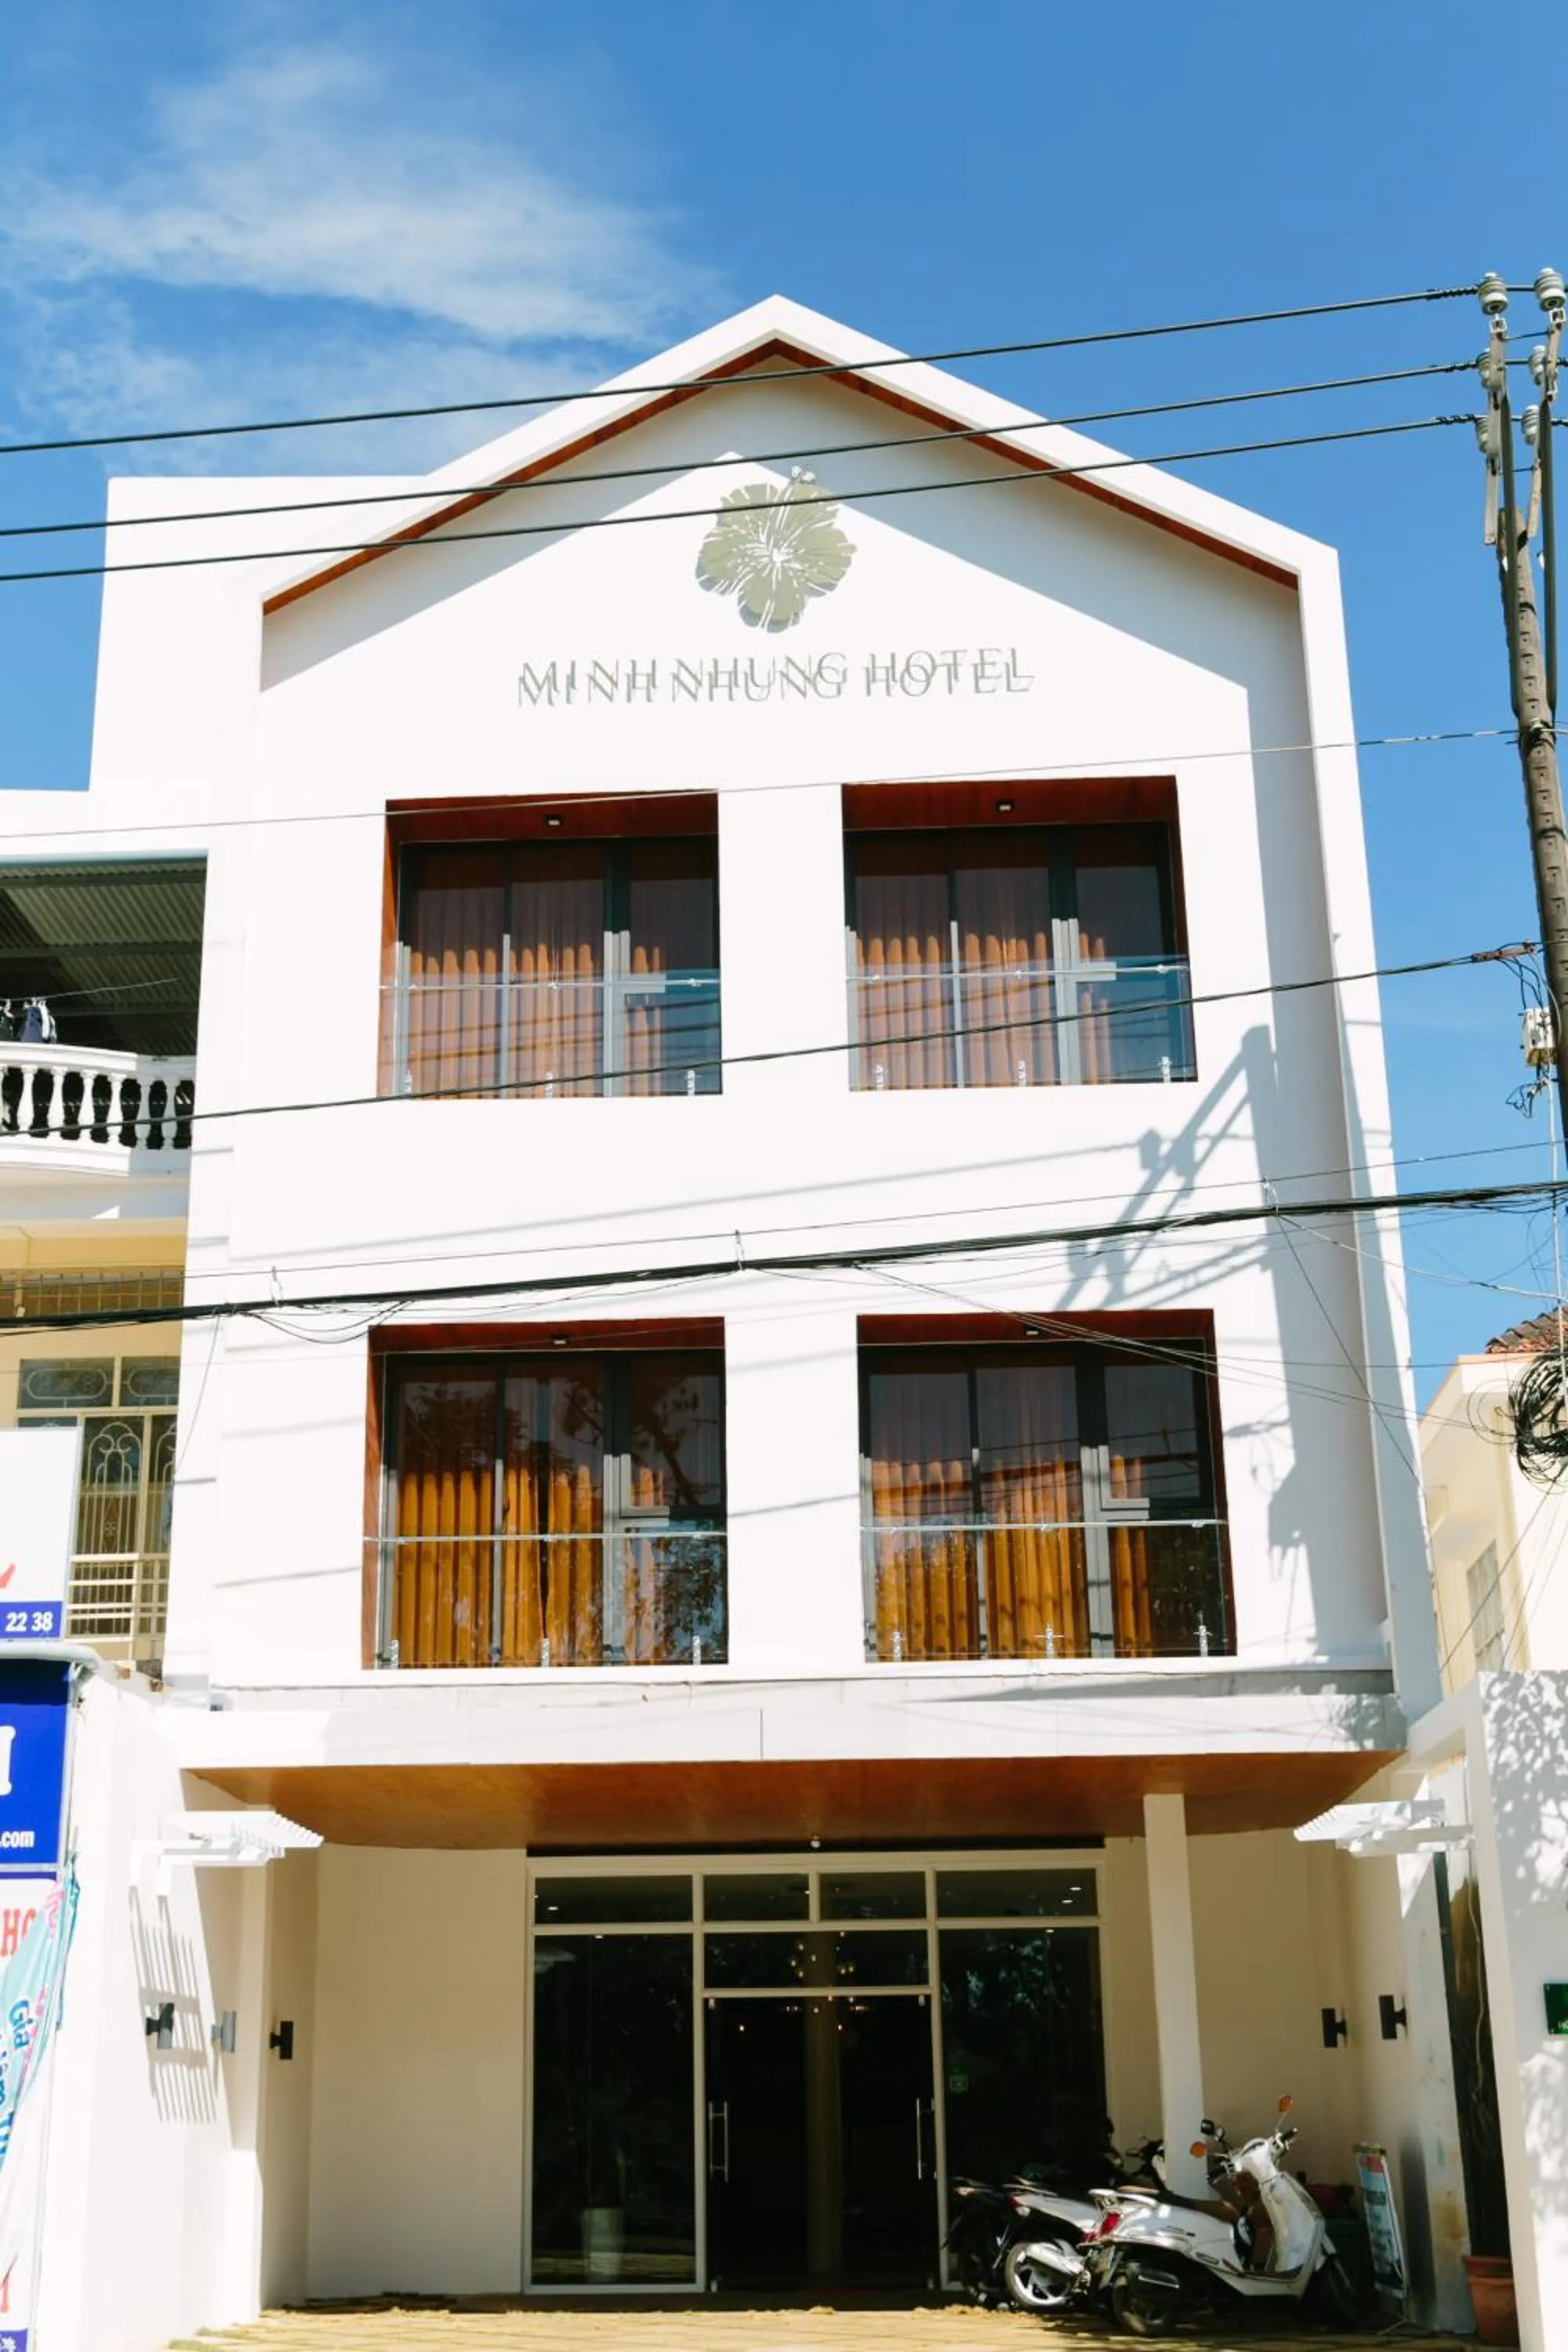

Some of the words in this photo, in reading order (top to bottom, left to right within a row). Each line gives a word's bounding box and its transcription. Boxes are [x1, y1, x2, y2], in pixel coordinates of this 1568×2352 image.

[518, 659, 656, 706] MINH
[670, 652, 848, 702] NHUNG
[863, 648, 1035, 697] HOTEL
[5, 1611, 27, 1632] 22
[31, 1611, 53, 1632] 38
